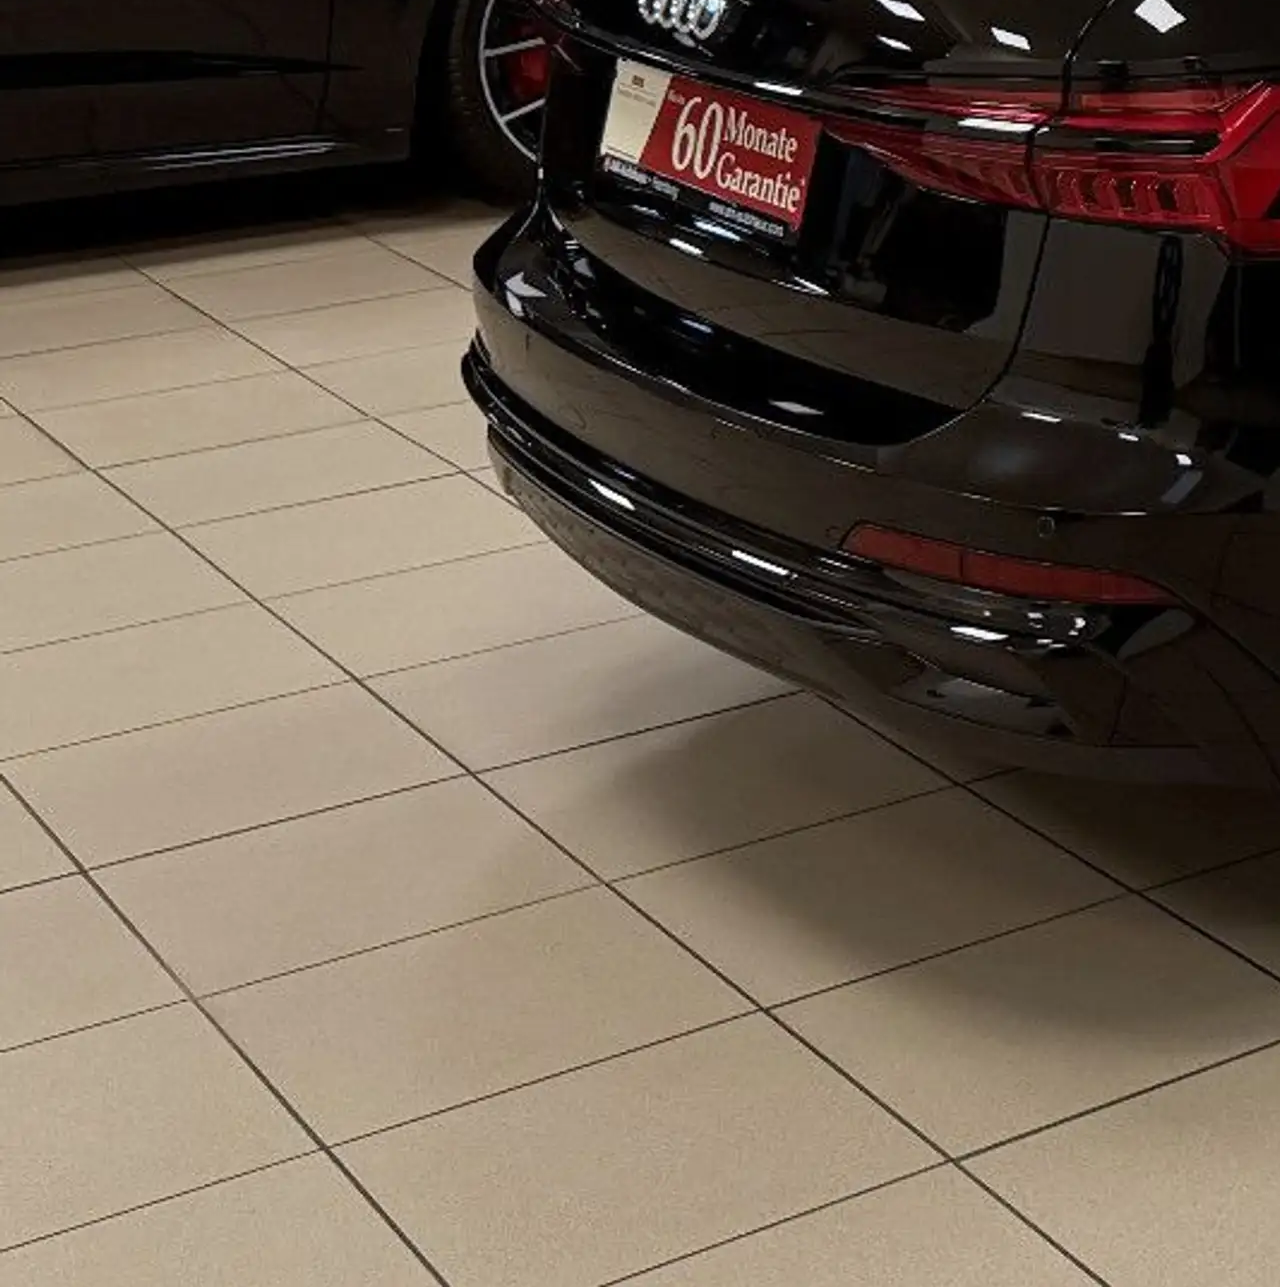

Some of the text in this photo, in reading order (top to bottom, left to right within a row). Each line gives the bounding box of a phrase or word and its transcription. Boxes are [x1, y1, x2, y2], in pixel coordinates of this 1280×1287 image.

[672, 96, 724, 180] 60
[723, 106, 798, 163] Monate
[715, 152, 801, 212] Garantie
